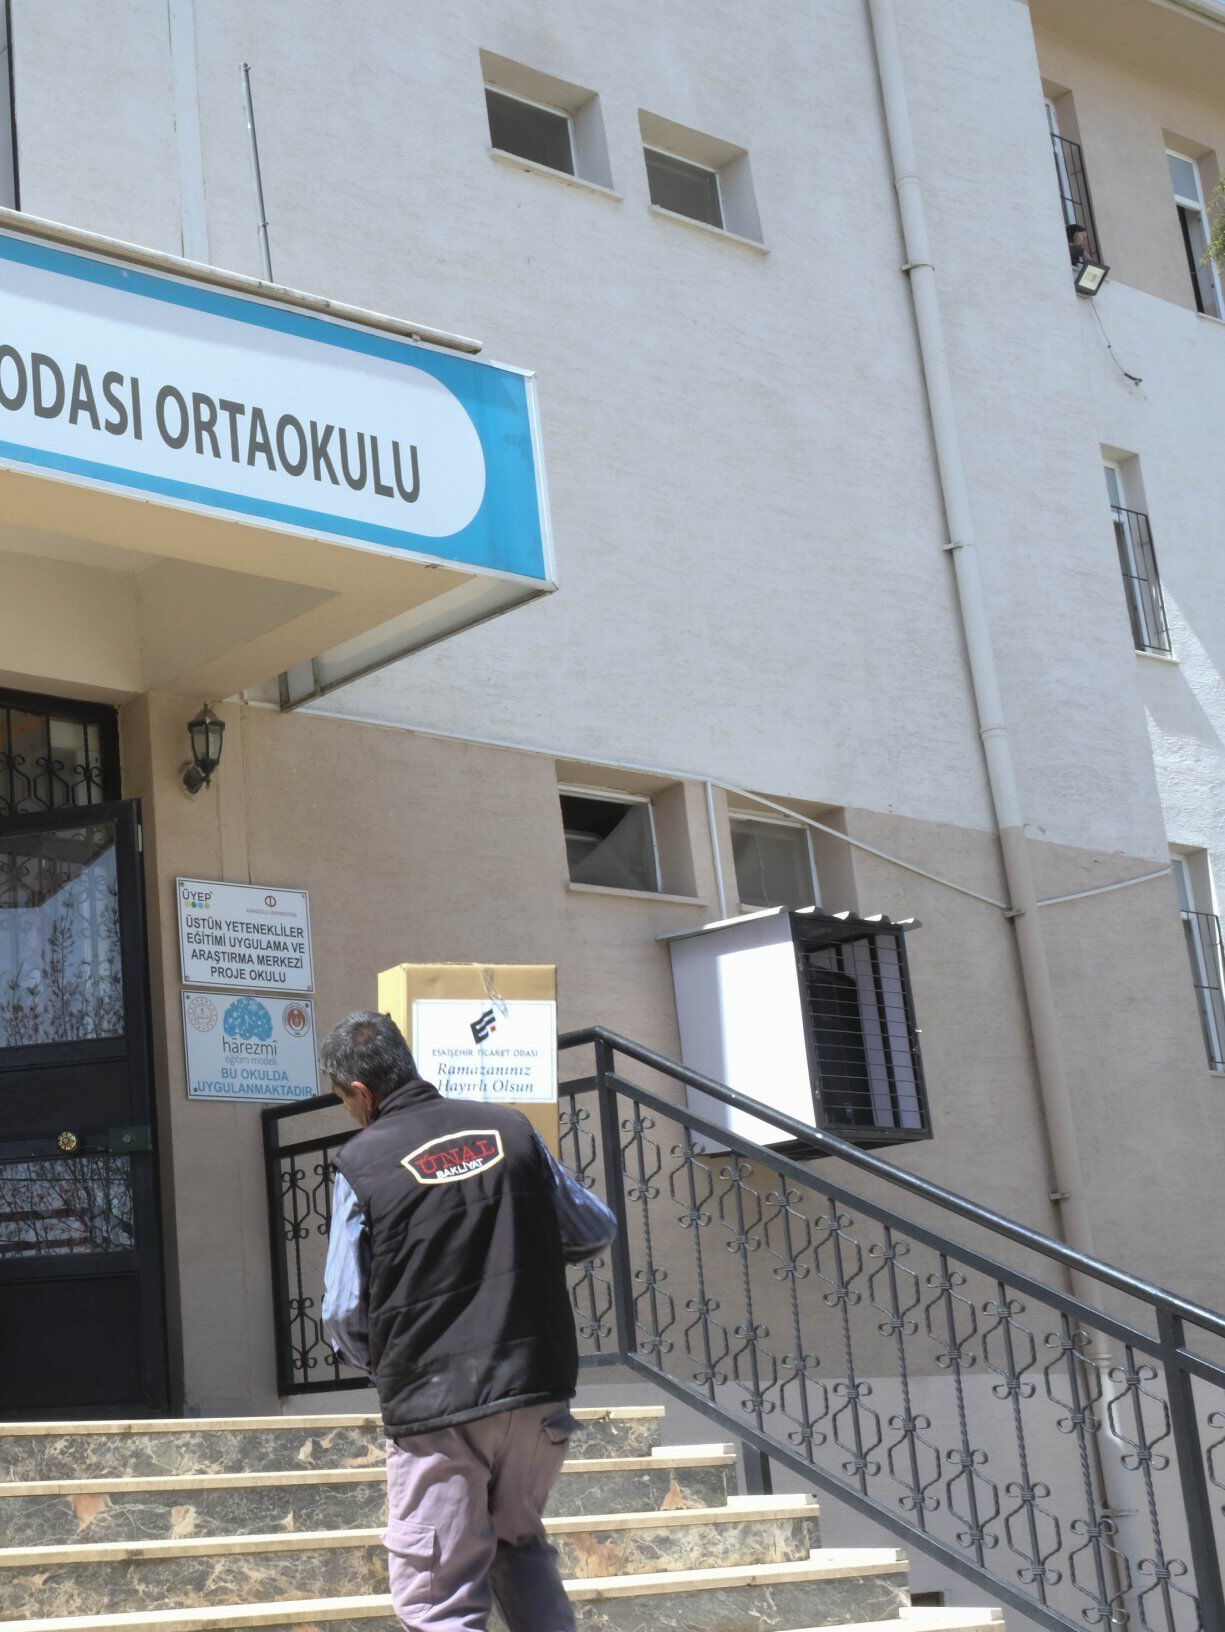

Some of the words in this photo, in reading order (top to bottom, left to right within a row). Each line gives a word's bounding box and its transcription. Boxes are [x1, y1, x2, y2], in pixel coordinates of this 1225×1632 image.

[155, 384, 421, 503] ORTAOKULU
[182, 888, 212, 902] ÜYEP
[186, 914, 222, 931] ÜSTÜN
[225, 920, 304, 938] YETENEKLİLER
[187, 931, 226, 947] EĞİTİMİ
[229, 937, 289, 953] UYGULAMA
[291, 942, 305, 954] VE
[191, 949, 254, 965] ARAŞTIRMA
[257, 954, 303, 969] MERKEZİ
[211, 966, 246, 979] PROJE
[249, 970, 286, 983] OKULU
[513, 1049, 538, 1057] ODASI
[221, 1067, 237, 1079] BU
[241, 1068, 289, 1081] OKULDA
[437, 1062, 531, 1076] Ramazanınız
[197, 1080, 312, 1097] UYGULANMAKTADIR
[438, 1079, 487, 1095] Hayırlı
[493, 1079, 533, 1092] Olsun
